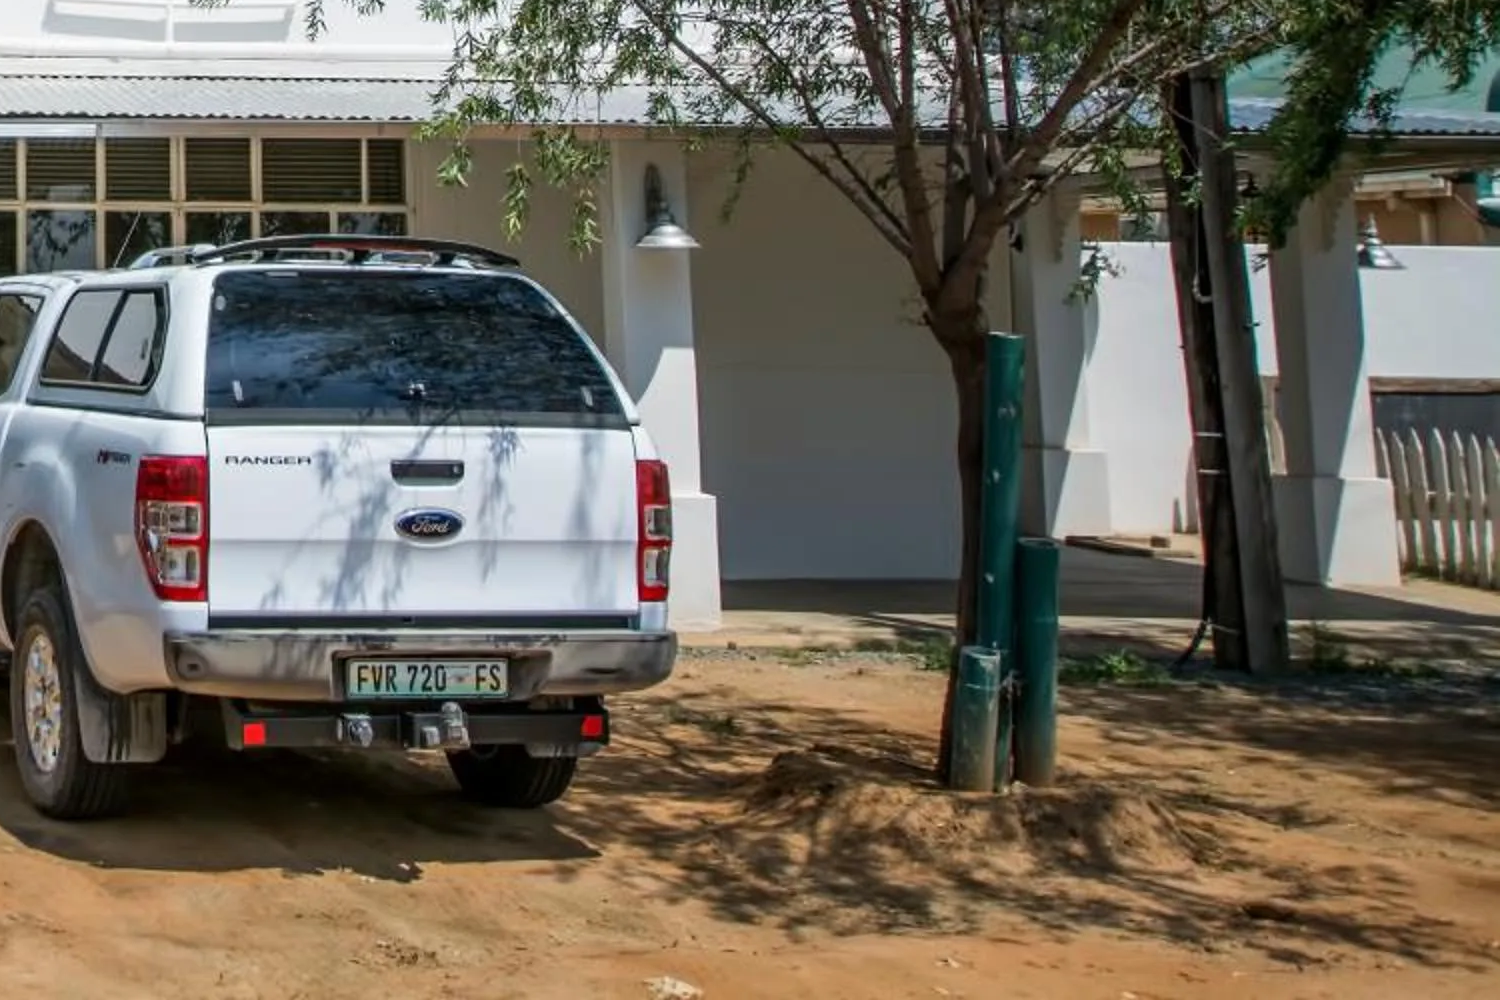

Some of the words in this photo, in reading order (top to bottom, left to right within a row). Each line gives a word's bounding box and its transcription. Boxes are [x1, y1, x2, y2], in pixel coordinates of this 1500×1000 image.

[225, 455, 311, 465] RANGER
[411, 516, 451, 533] Ford
[357, 664, 397, 692] FVR
[407, 664, 447, 692] 720
[475, 664, 501, 691] FS
